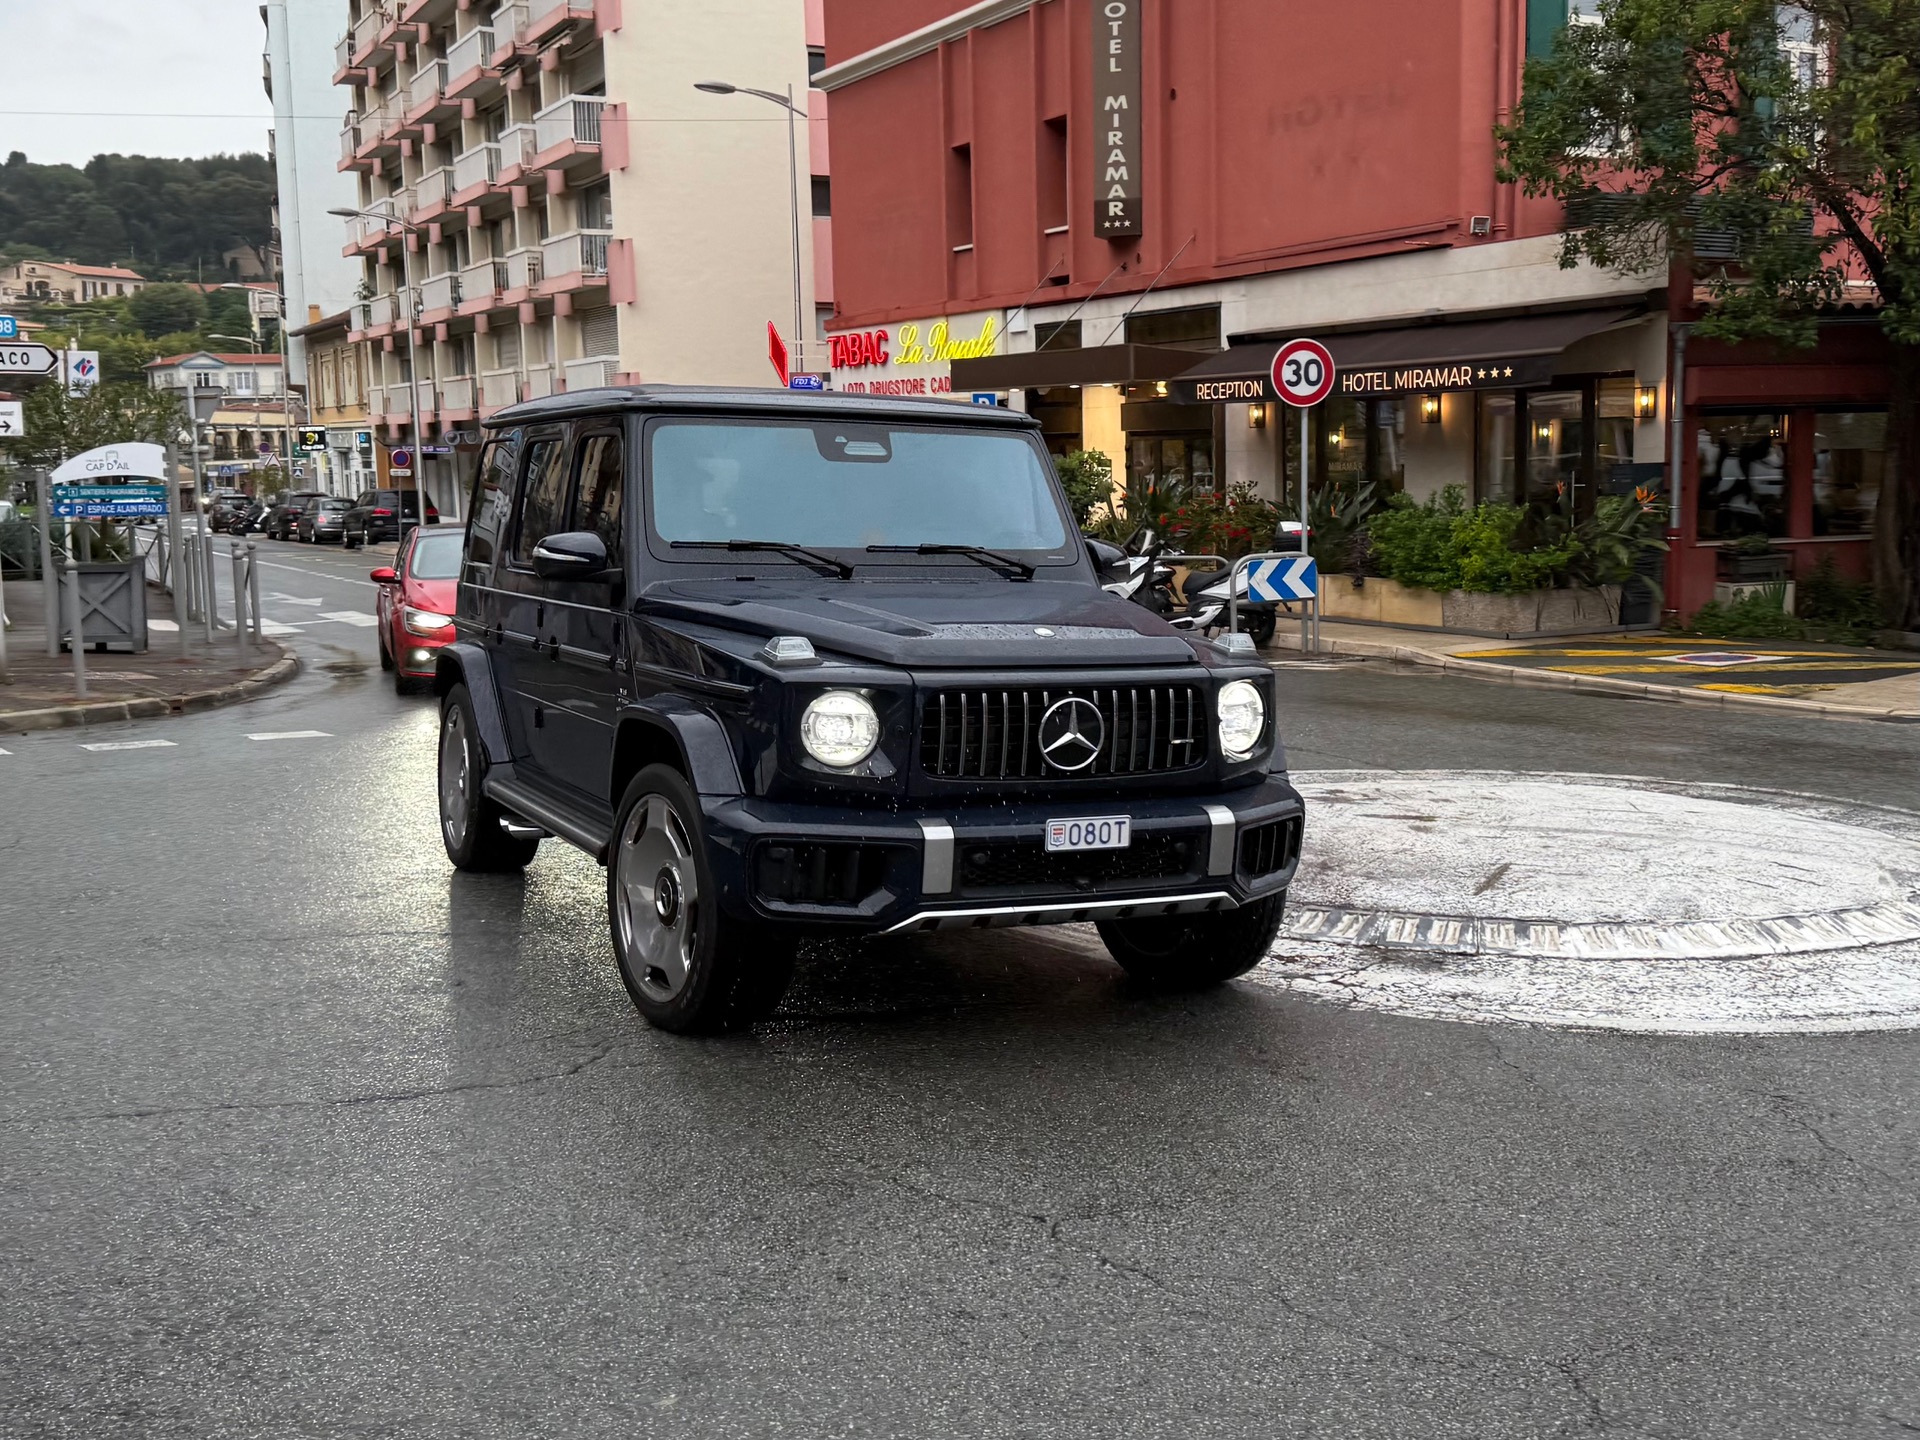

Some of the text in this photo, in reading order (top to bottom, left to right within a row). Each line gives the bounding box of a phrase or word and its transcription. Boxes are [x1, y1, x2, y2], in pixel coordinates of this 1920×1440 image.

[1104, 2, 1129, 216] OTEL MIRAMAR
[826, 329, 889, 369] TABAC
[895, 326, 924, 364] La
[793, 377, 809, 386] FDJ
[1284, 358, 1323, 388] 30
[1343, 366, 1472, 392] HOTEL MIRAMAR
[870, 378, 926, 395] DRUGSTORE
[1196, 380, 1263, 400] RECEPTION
[86, 462, 105, 471] CAP
[88, 505, 116, 514] ESPACE
[117, 504, 138, 513] ALAIN
[138, 504, 163, 513] PRADO
[1069, 820, 1127, 846] 080T
